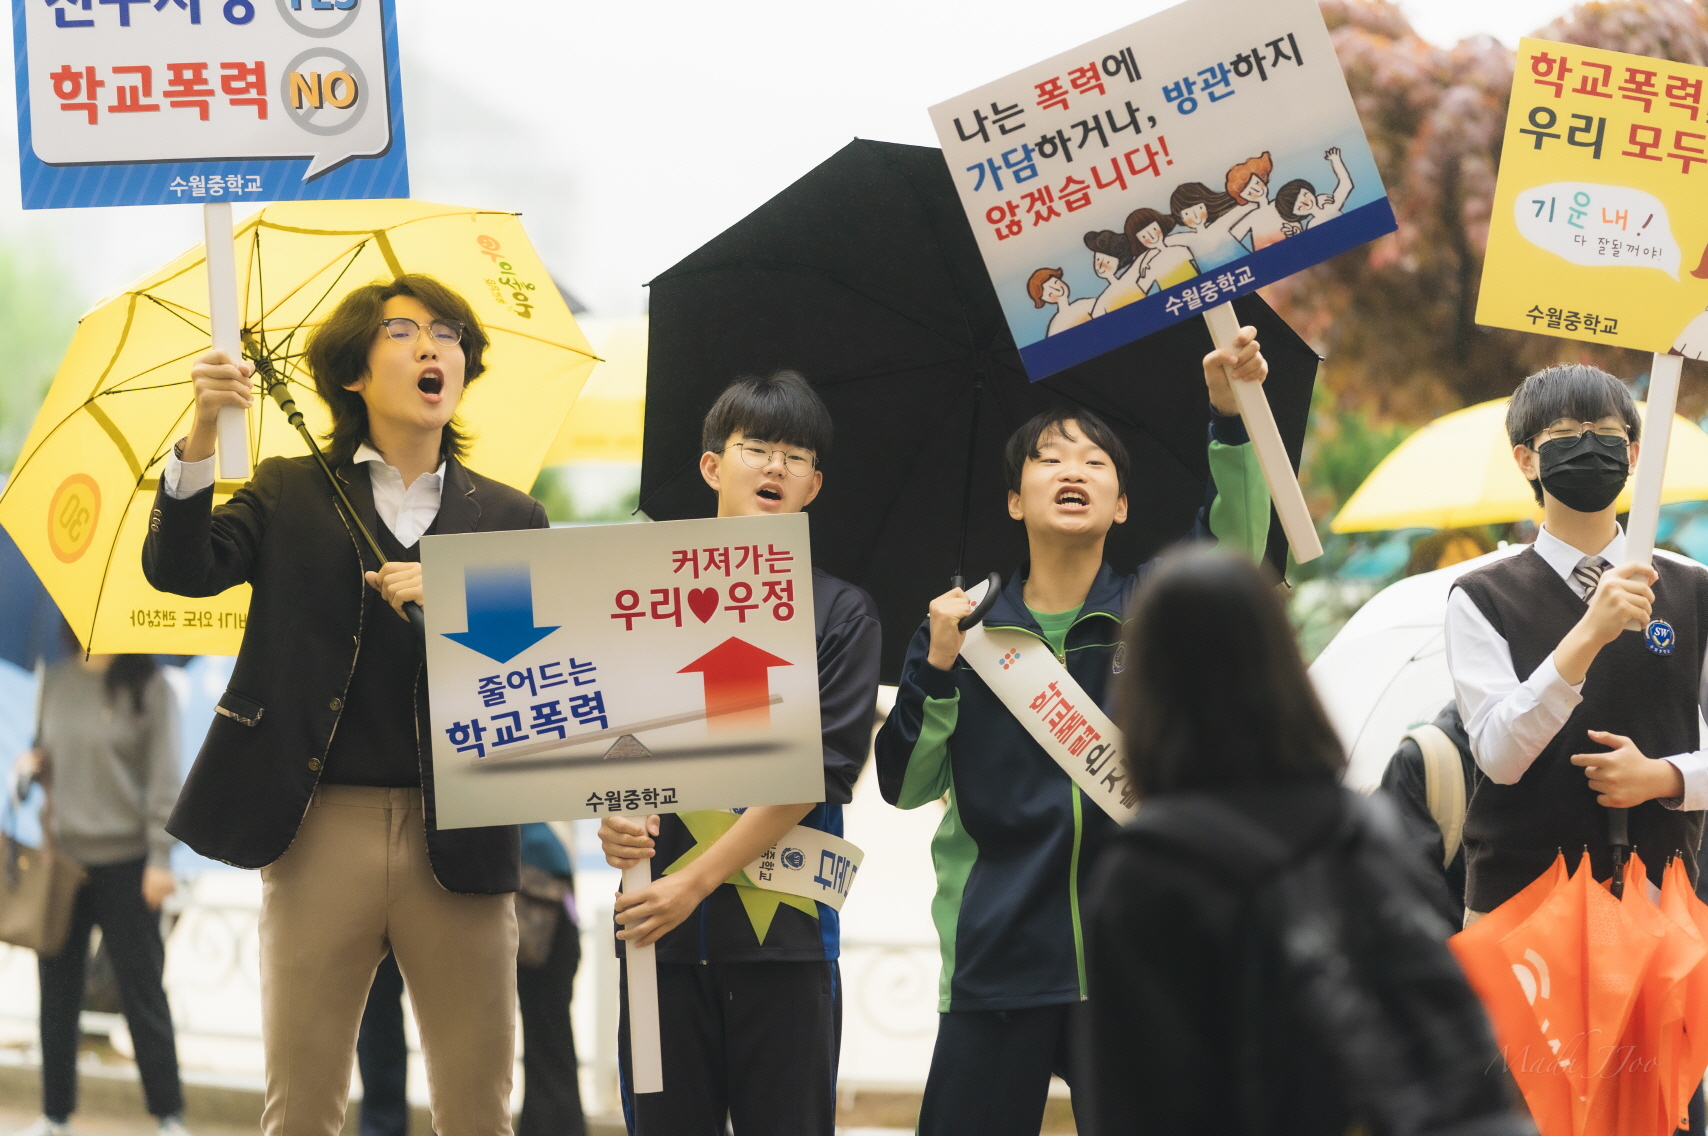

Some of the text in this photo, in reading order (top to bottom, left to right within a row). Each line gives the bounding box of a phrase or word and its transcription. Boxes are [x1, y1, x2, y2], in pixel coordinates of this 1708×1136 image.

[49, 60, 268, 125] 학교폭력
[289, 71, 359, 110] NO
[953, 47, 1142, 144] 나는 폭력에
[1530, 51, 1708, 121] 학교폭력
[966, 33, 1304, 193] 가담하거나, 방관하지
[1519, 106, 1708, 175] 우리 모두
[169, 174, 263, 197] 수월중학교
[985, 135, 1174, 241] 않겠습니다!
[1164, 266, 1256, 317] 수월중학교
[1526, 304, 1619, 335] 수월중학교
[671, 543, 795, 579] 커져가는
[1654, 627, 1670, 637] SW
[477, 657, 597, 708] 줄어드는
[445, 690, 609, 758] 학교폭력
[1029, 680, 1117, 777] 학교폭력은
[585, 787, 678, 813] 수월중학교
[759, 843, 777, 881] 중학교
